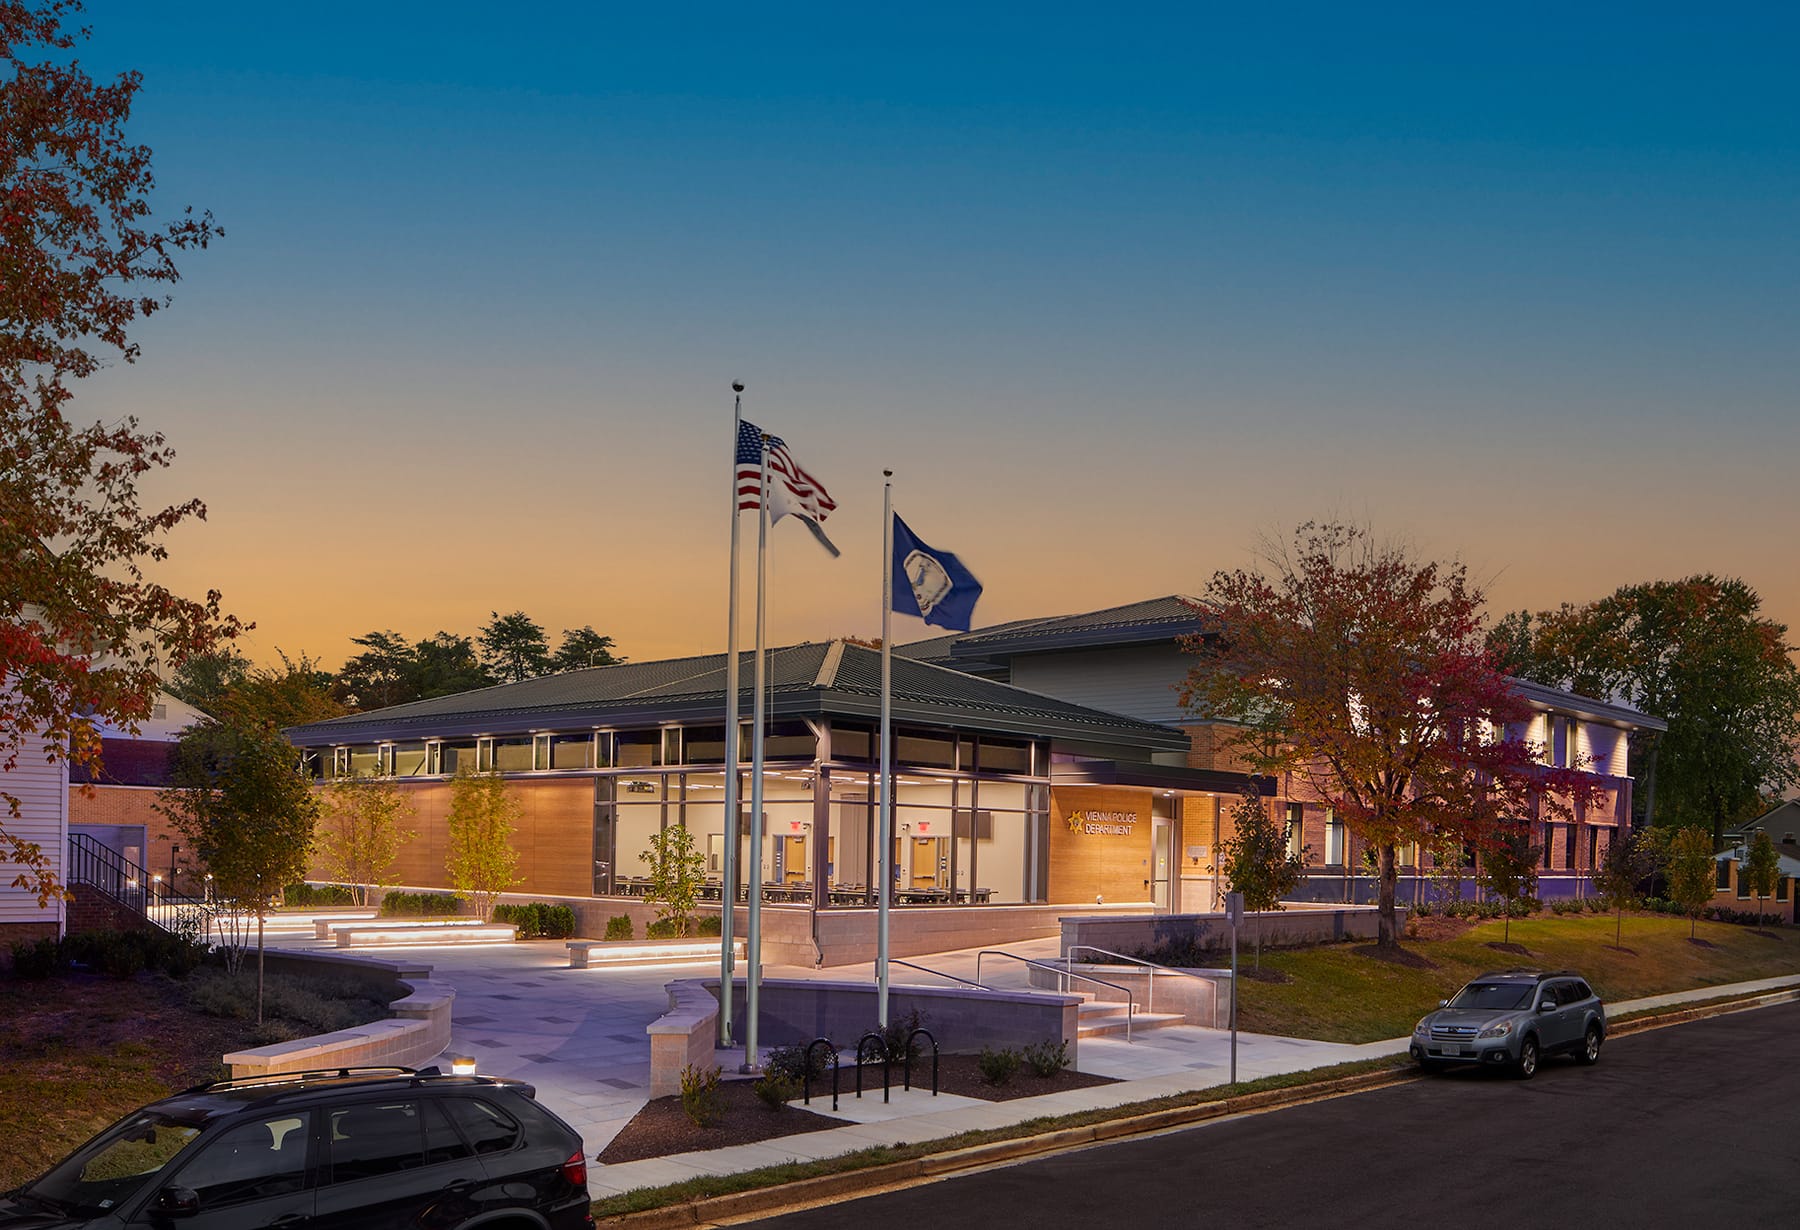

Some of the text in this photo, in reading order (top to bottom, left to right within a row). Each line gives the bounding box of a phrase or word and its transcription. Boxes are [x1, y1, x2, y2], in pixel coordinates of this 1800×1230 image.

[1085, 811, 1137, 823] VIENNA POLICE
[1085, 823, 1132, 835] DEPARTMENT
